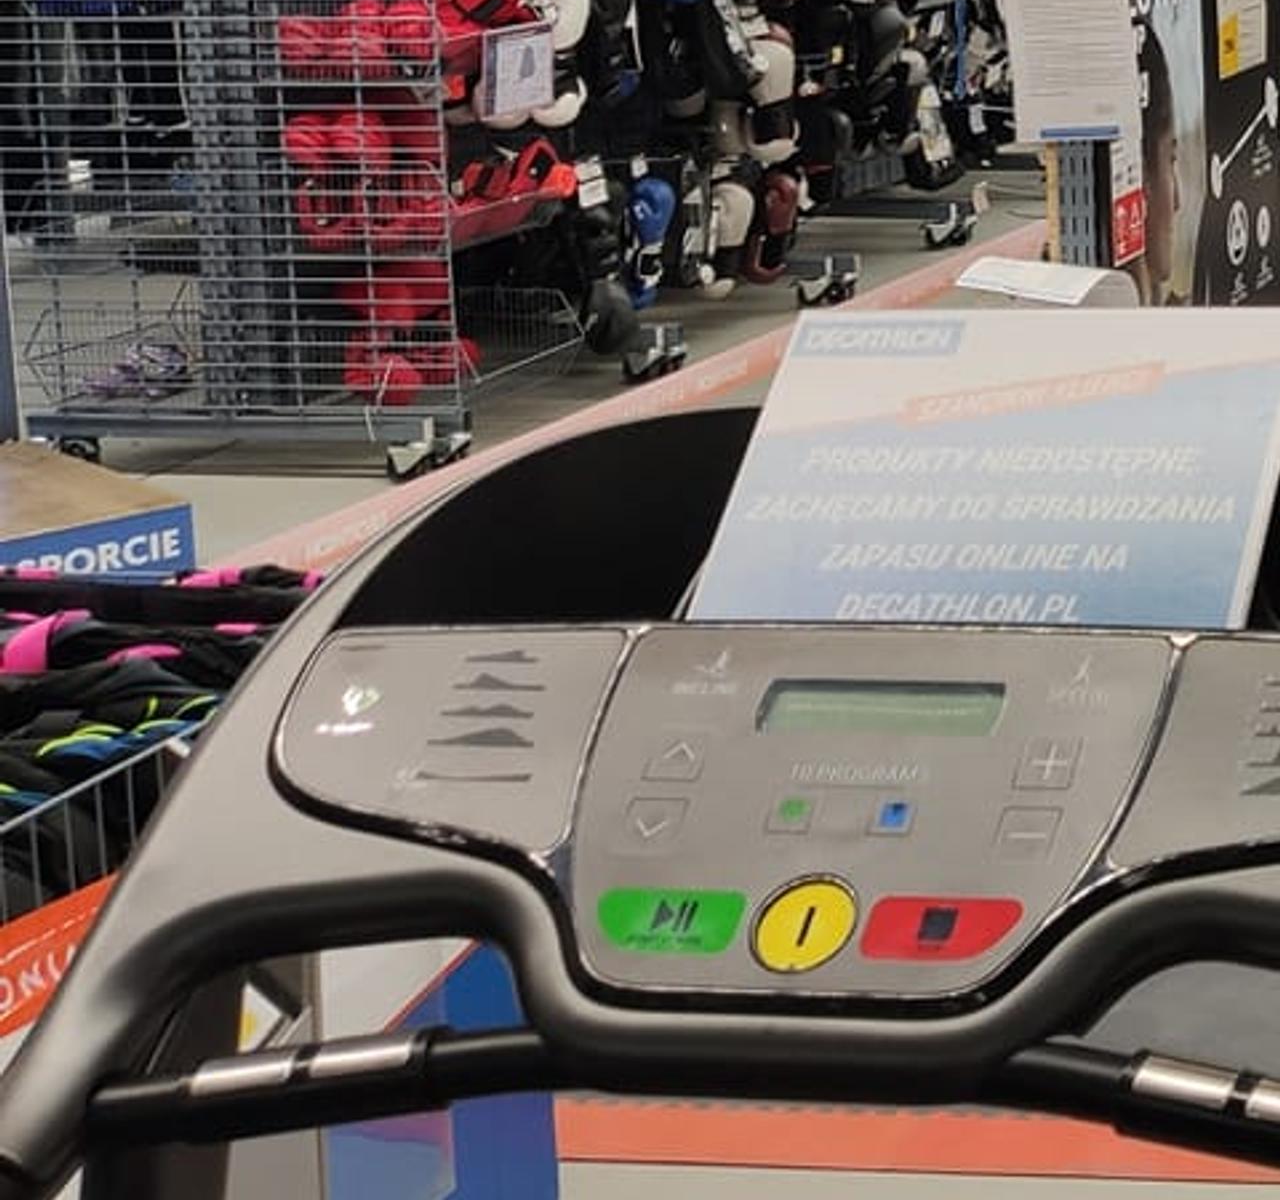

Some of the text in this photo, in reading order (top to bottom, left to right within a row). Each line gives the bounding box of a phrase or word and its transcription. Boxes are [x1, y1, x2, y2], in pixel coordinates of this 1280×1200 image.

[800, 446, 976, 475] PRODUKTY
[744, 495, 1236, 523] ZACHĘCAMY DO SPRAWDZANIA
[818, 543, 1130, 572] ZAPASU ONLINE NA
[834, 593, 1081, 622] DECATHLON.PL
